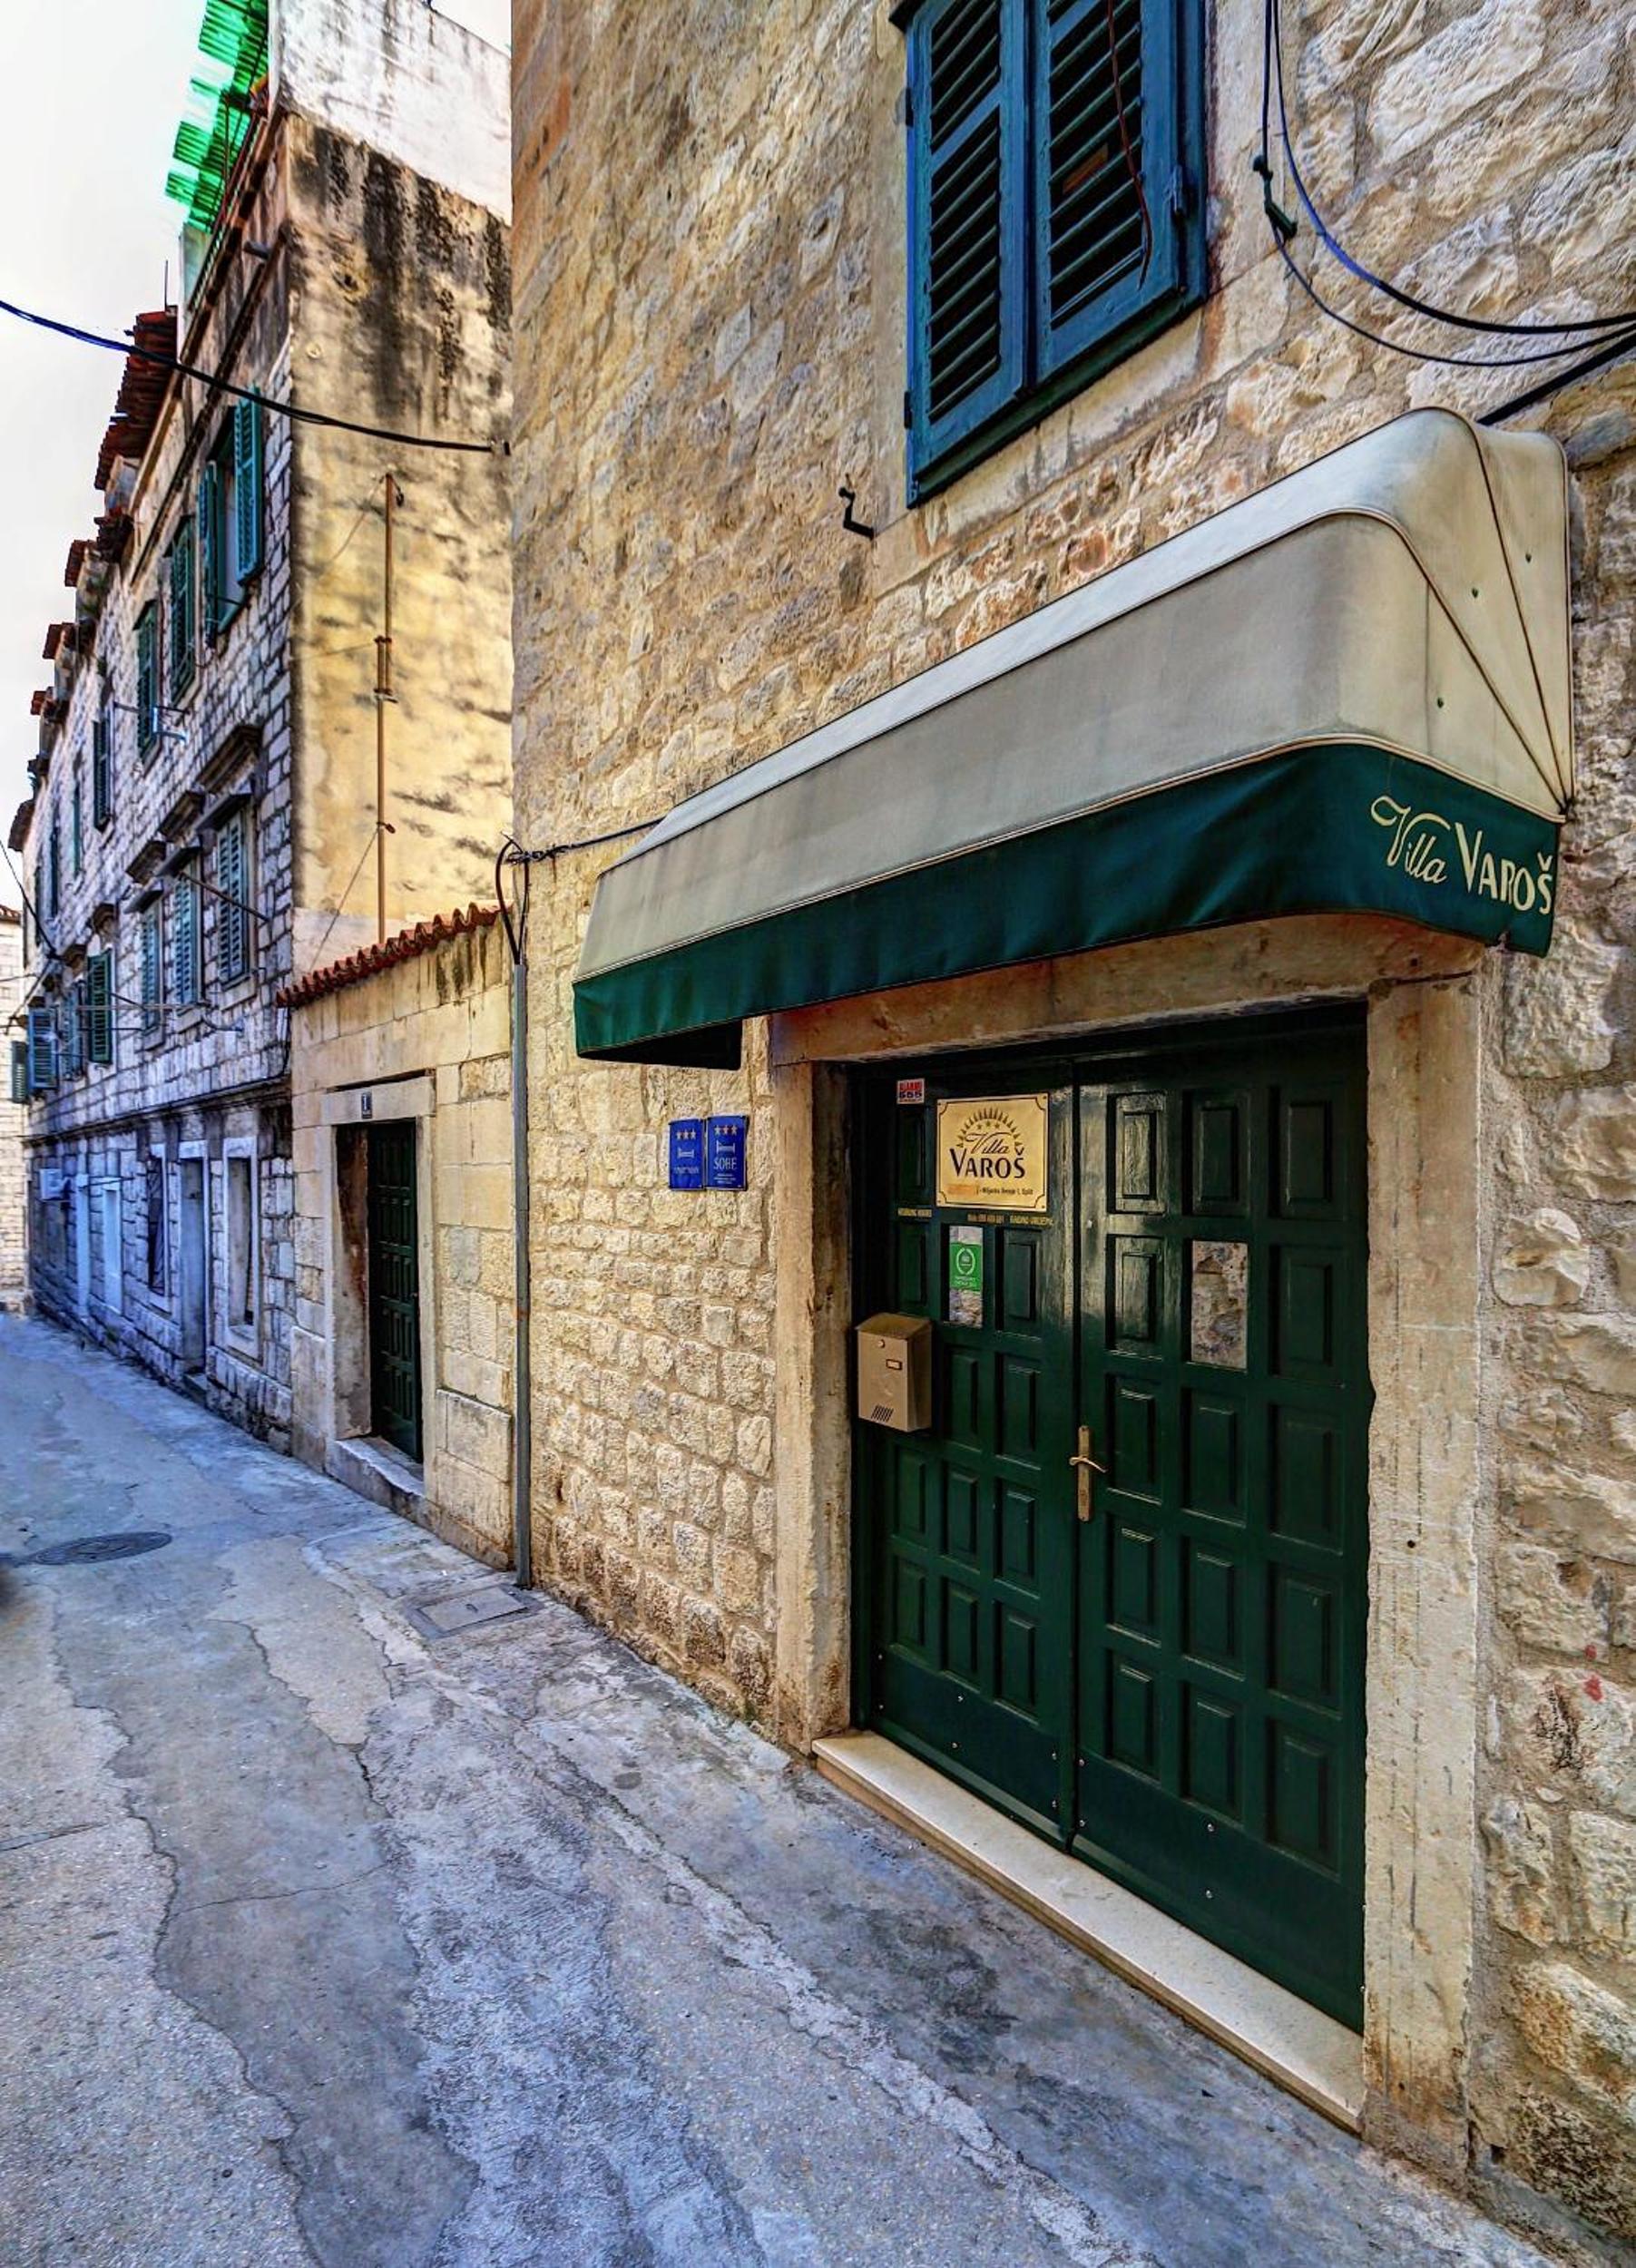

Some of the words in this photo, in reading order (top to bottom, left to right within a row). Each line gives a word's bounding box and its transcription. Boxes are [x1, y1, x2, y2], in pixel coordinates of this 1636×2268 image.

[1370, 795, 1451, 884] Villa
[1455, 822, 1553, 914] VAROŠ
[965, 1131, 1012, 1155] Villa
[949, 1147, 1026, 1179] VAROŠ
